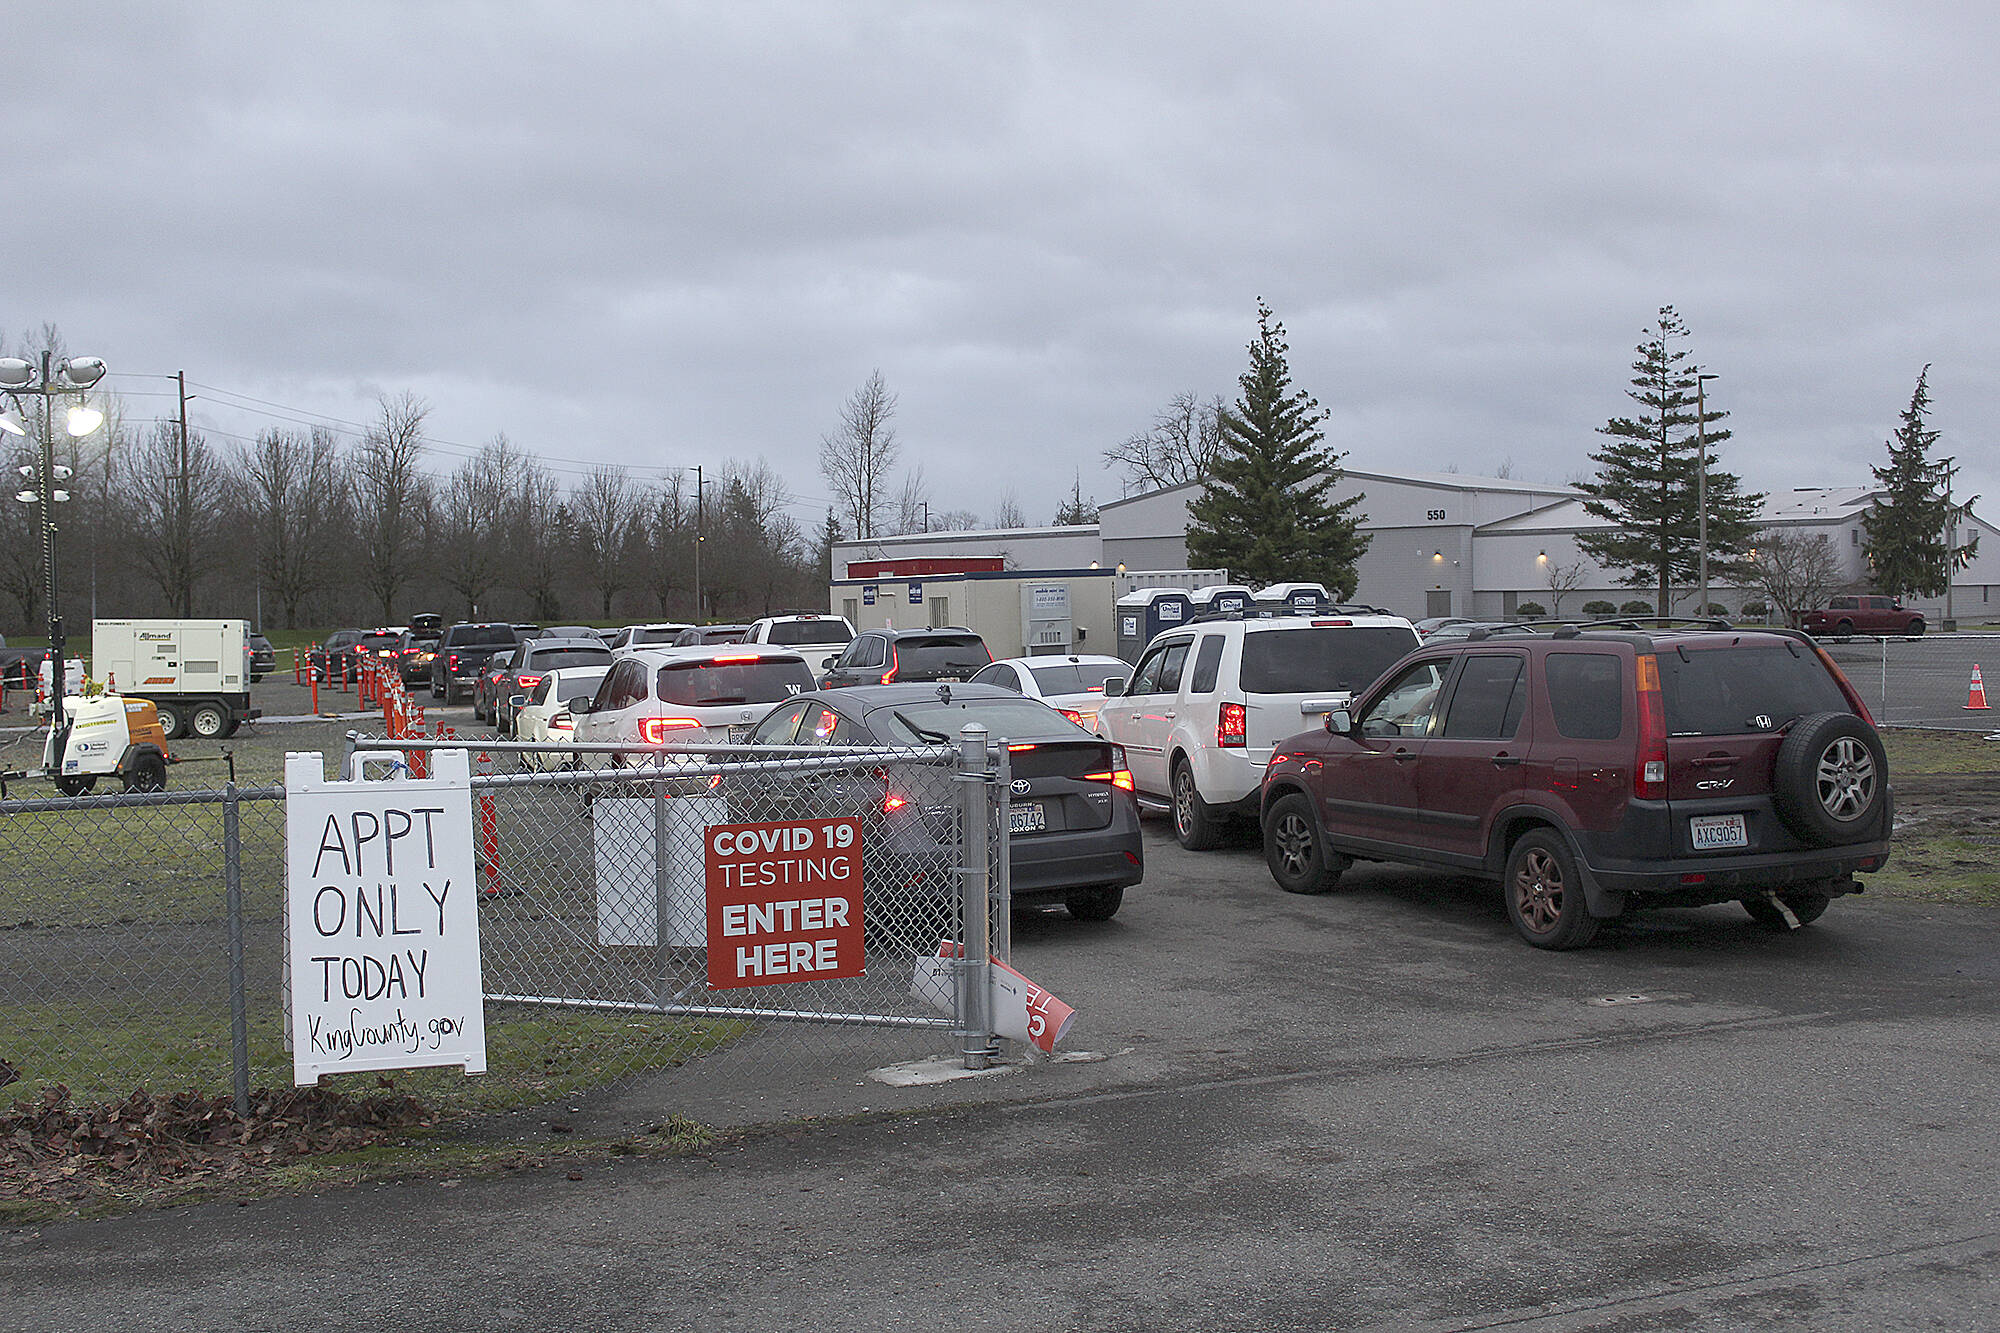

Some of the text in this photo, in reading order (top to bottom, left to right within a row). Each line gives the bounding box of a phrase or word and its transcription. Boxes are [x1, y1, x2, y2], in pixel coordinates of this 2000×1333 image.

[1427, 509, 1446, 520] 550
[785, 684, 801, 695] W
[1010, 812, 1043, 828] R6742
[1697, 825, 1742, 843] AXC9057
[311, 807, 445, 878] APPT
[713, 824, 854, 856] COVID 19
[718, 856, 850, 888] TESTING
[313, 879, 451, 937] ONLY
[722, 897, 850, 937] ENTER
[310, 949, 427, 1002] TODAY
[736, 938, 838, 978] HERE
[307, 1007, 465, 1061] KingCounty.gov
